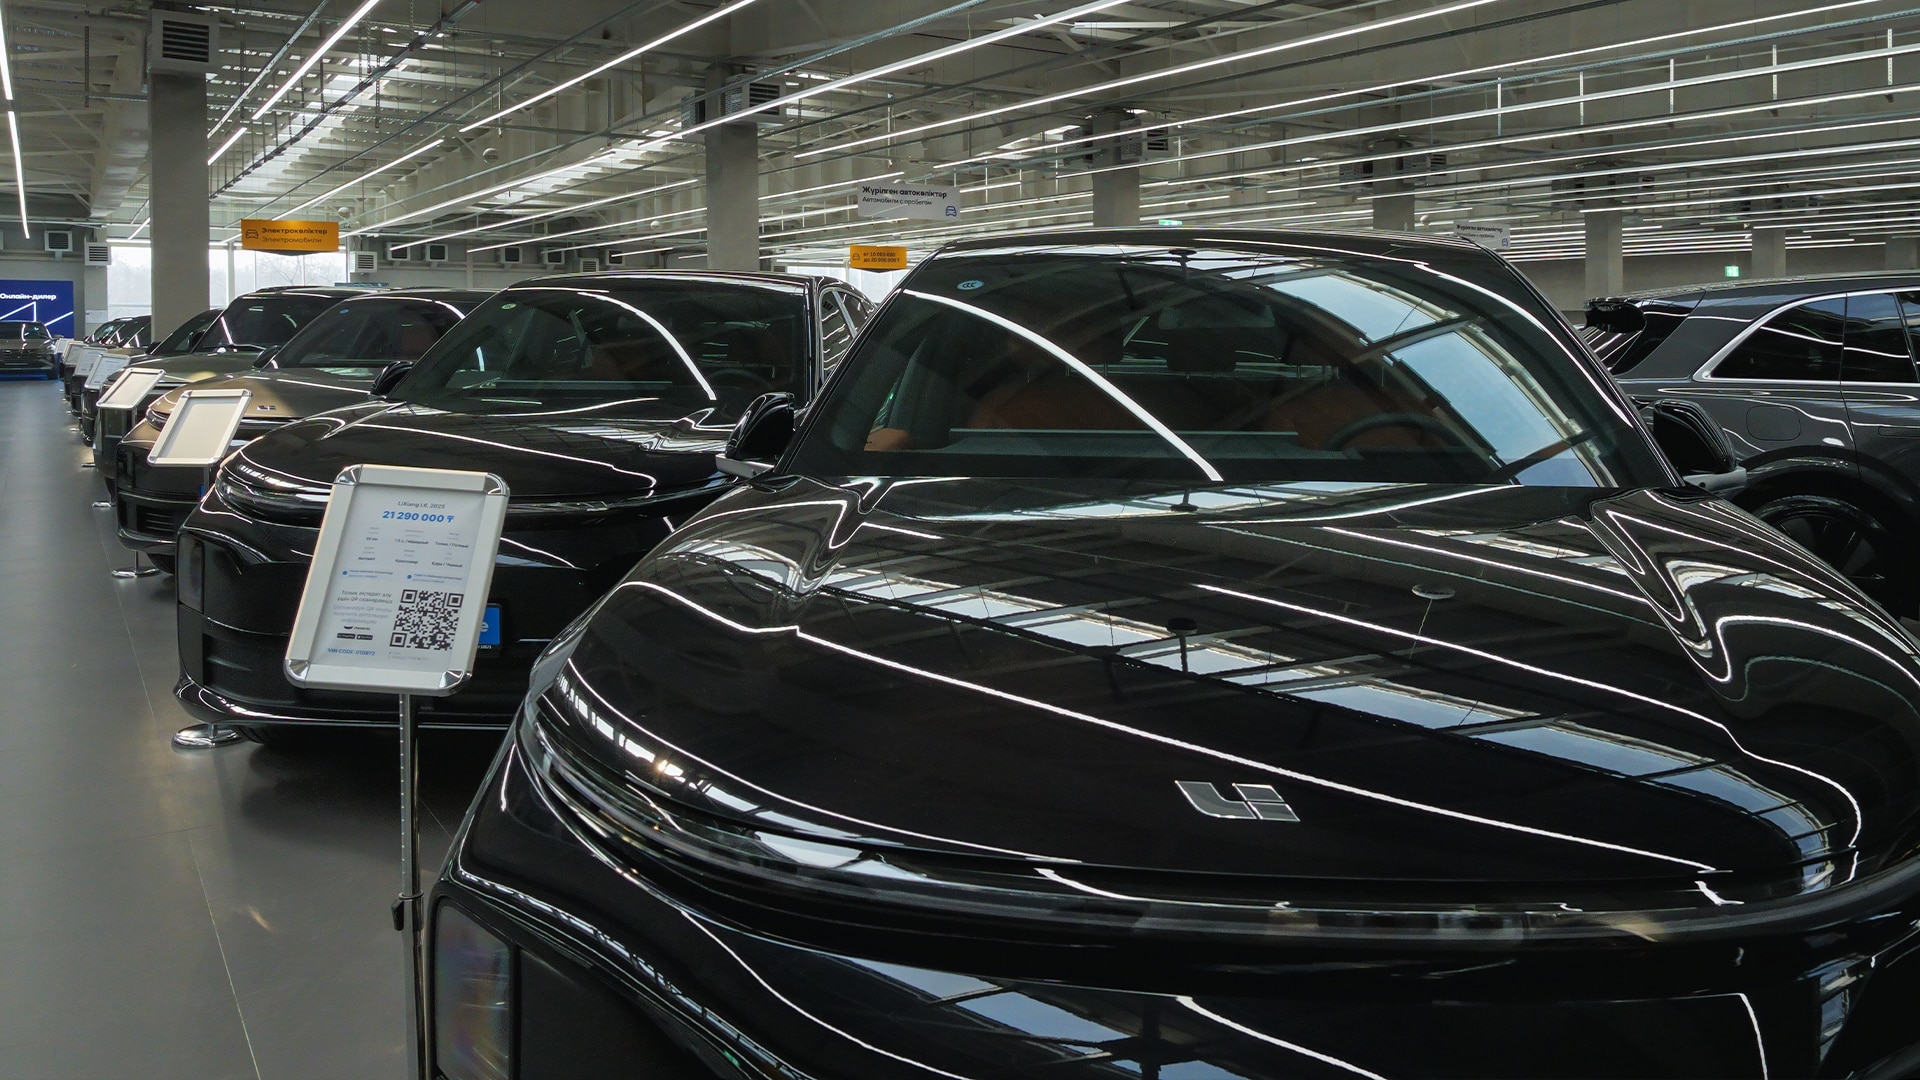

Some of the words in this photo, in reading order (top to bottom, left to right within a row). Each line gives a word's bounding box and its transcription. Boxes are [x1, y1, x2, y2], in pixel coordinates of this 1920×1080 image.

[862, 186, 898, 195] Жүрілген
[862, 196, 899, 204] Автомобили
[382, 511, 395, 519] 21
[398, 511, 419, 521] 290
[421, 513, 444, 523] 000
